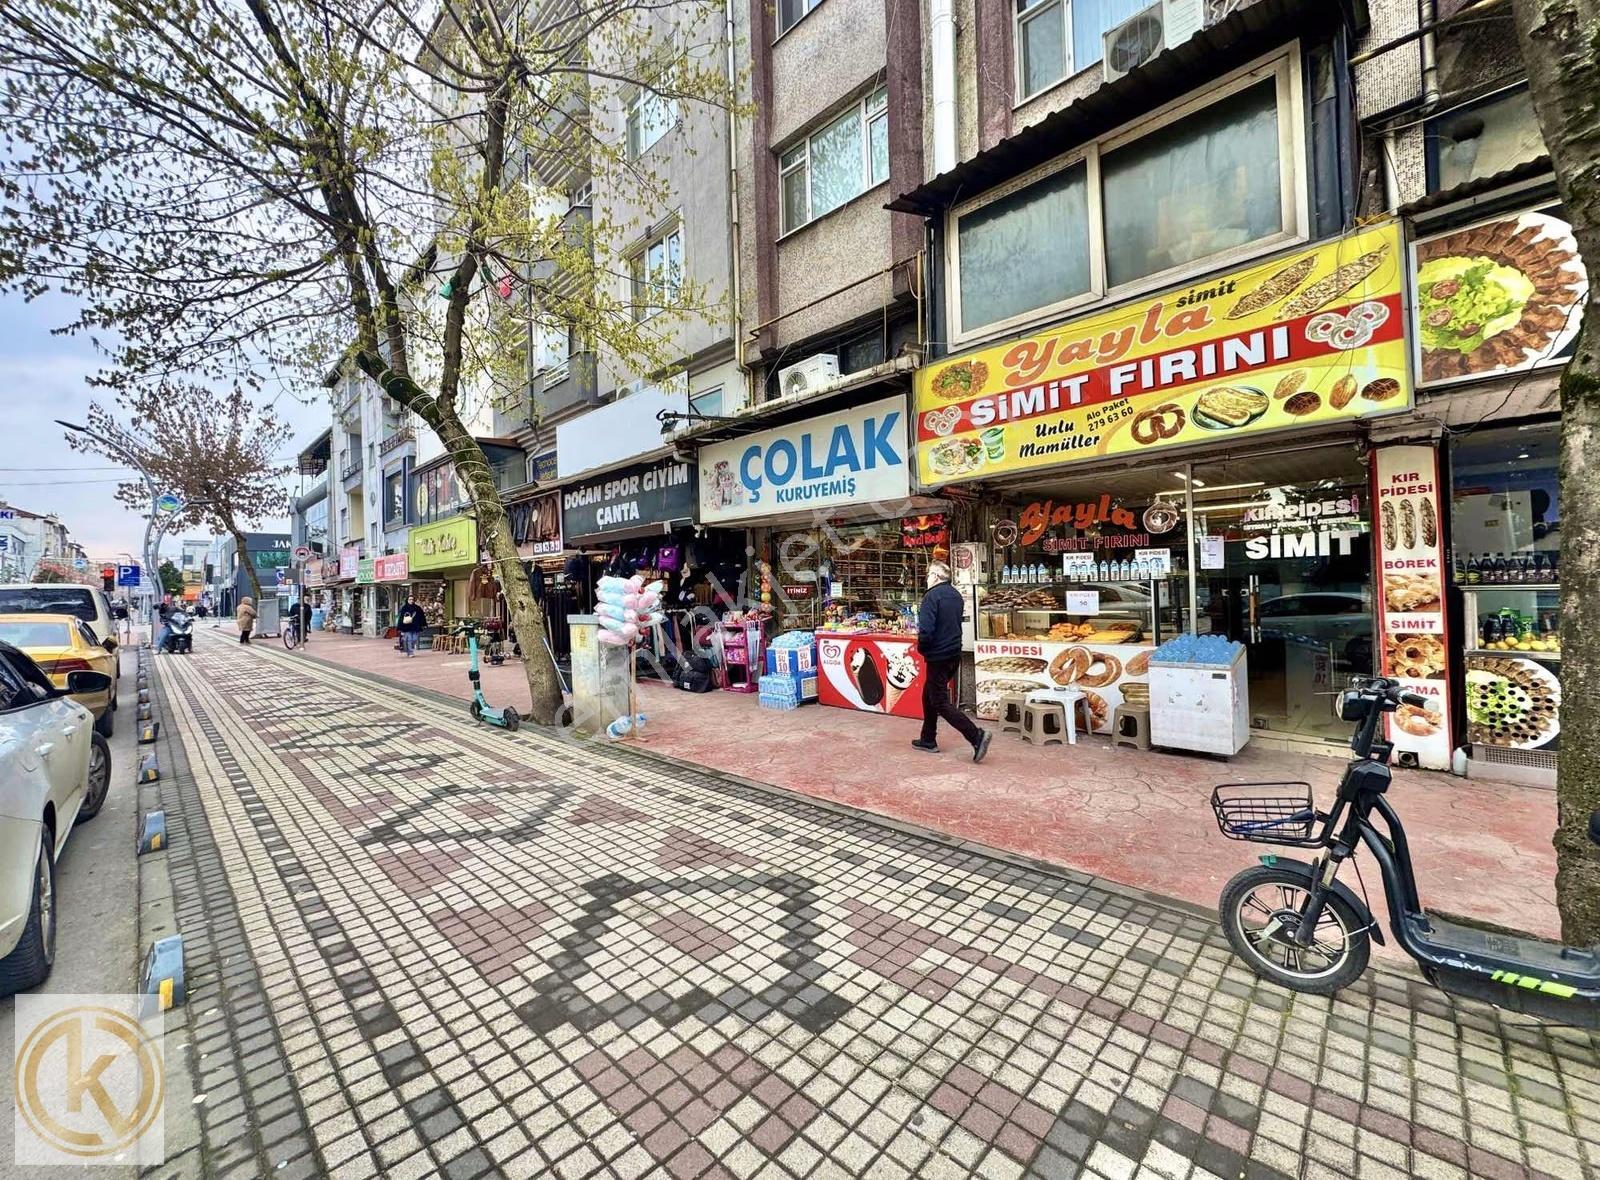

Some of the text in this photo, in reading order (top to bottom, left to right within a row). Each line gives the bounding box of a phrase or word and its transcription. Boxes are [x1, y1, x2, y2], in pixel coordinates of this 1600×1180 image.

[1175, 280, 1237, 309] simit
[1002, 301, 1215, 388] Yayla
[1109, 326, 1291, 397] FIRINI
[1086, 398, 1130, 422] Alo Paket
[1088, 406, 1134, 432] 279 63 60
[1035, 419, 1075, 438] Unlu
[739, 411, 903, 503] ÇOLAK
[1019, 434, 1100, 458] Mamüller
[564, 462, 688, 510] DOĞAN SPOR GİYİM
[776, 475, 857, 503] KURUYEMİŞ
[1380, 481, 1433, 497] PİDESİ
[1392, 472, 1420, 483] KIR
[596, 501, 640, 530] ÇANTA
[1019, 493, 1138, 546] Yayla
[120, 566, 133, 579] P
[1384, 558, 1437, 570] BÖREK
[976, 644, 998, 654] KIR
